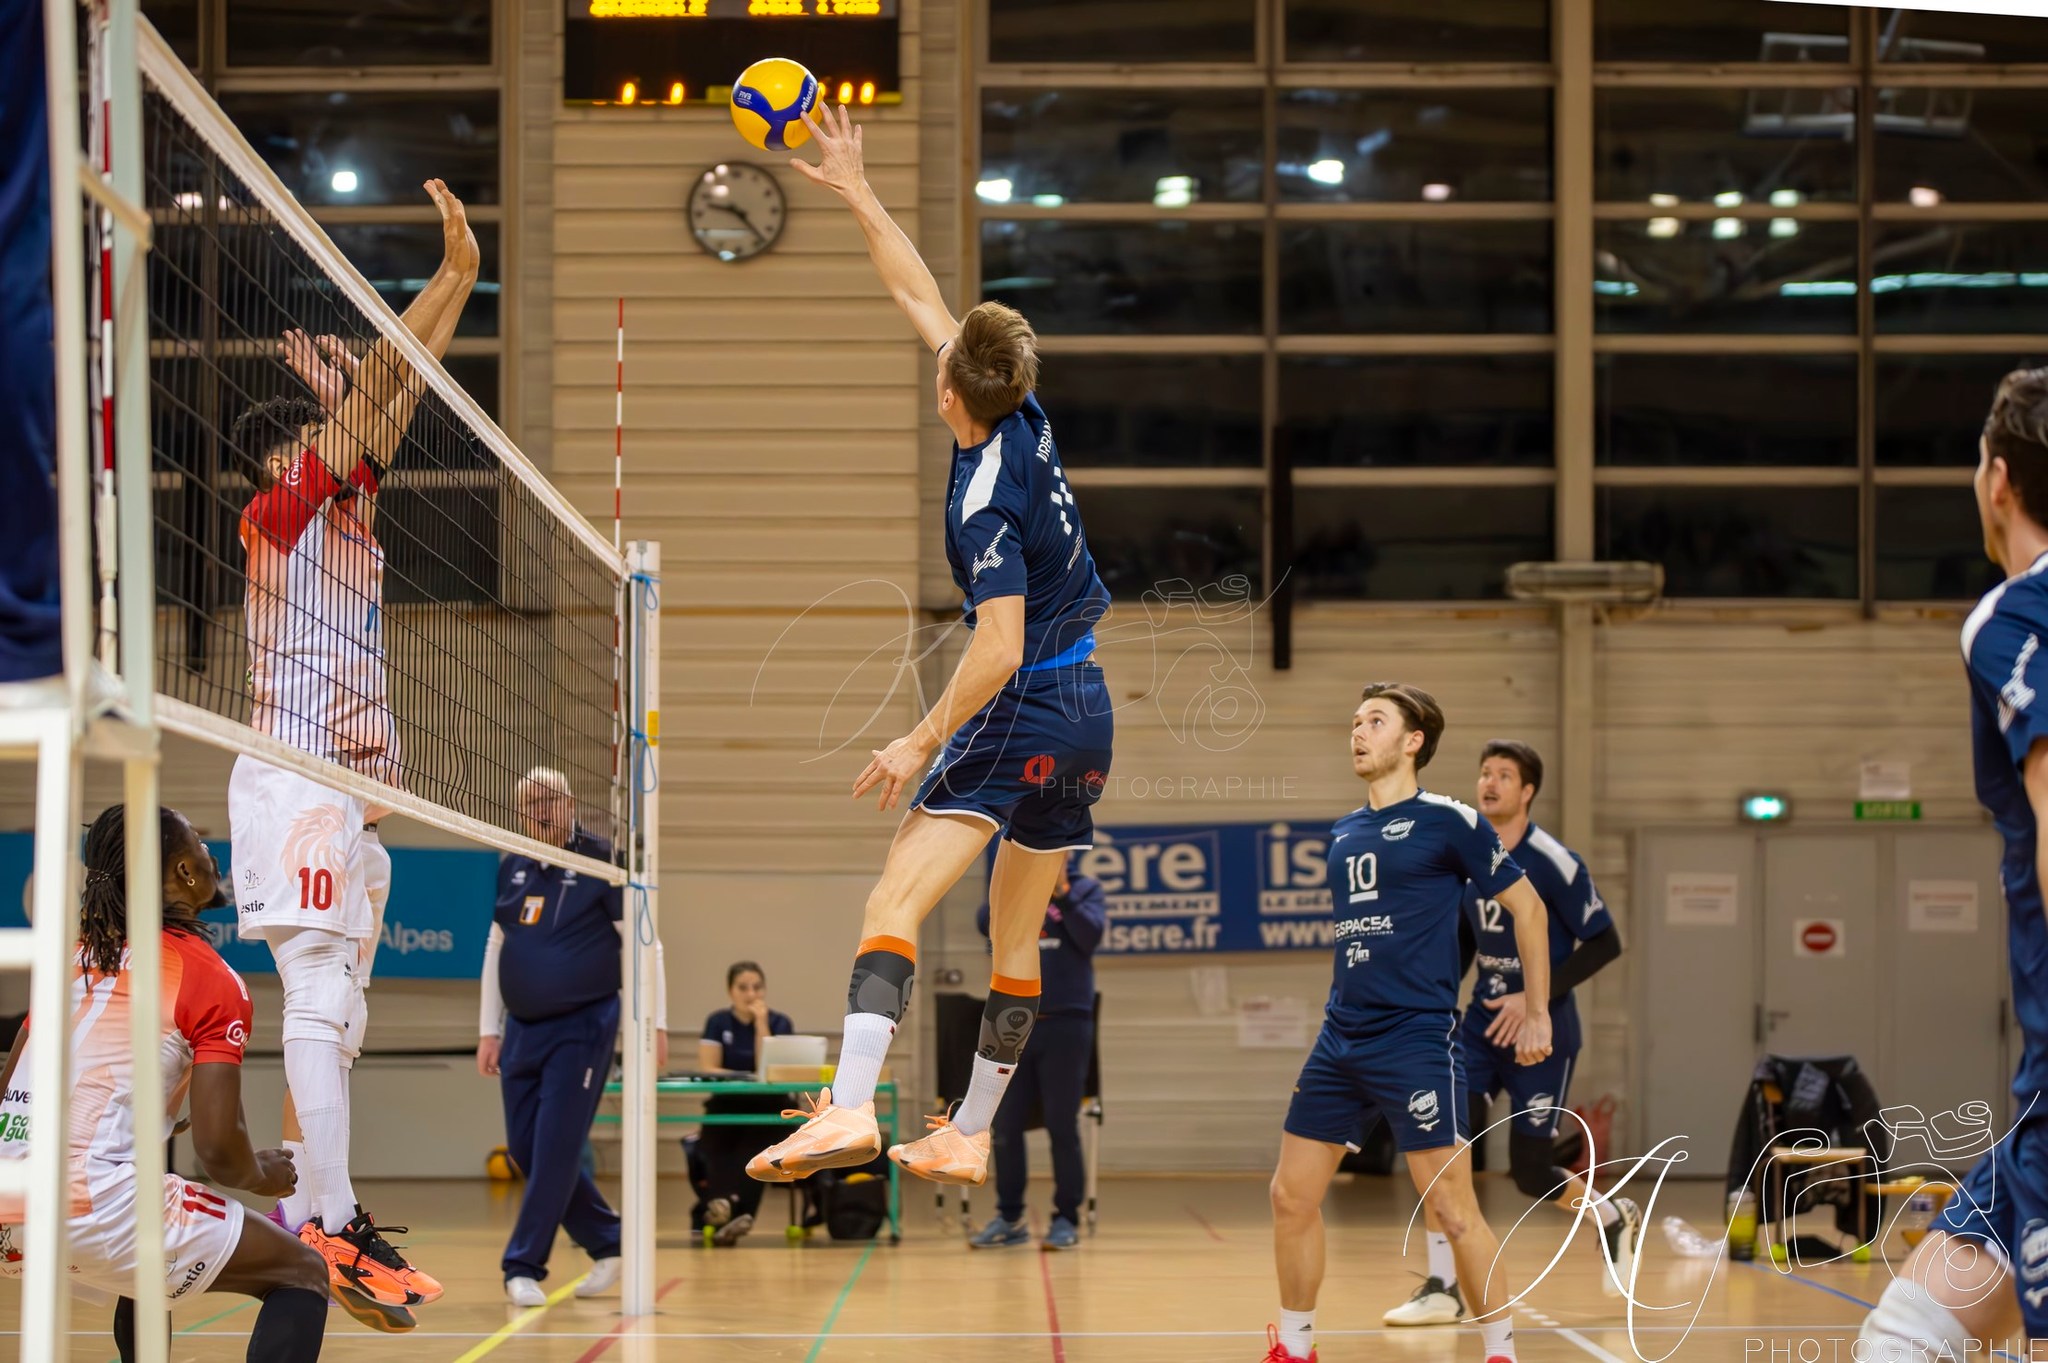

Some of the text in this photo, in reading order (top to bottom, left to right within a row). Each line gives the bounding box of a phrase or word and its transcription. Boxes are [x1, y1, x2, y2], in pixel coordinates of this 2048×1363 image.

[1268, 823, 1328, 887] is
[1346, 852, 1377, 893] 10
[298, 867, 332, 911] 10
[1335, 915, 1393, 938] ESPACE4
[1476, 898, 1505, 932] 12
[1260, 921, 1335, 947] www
[182, 1184, 226, 1221] 11
